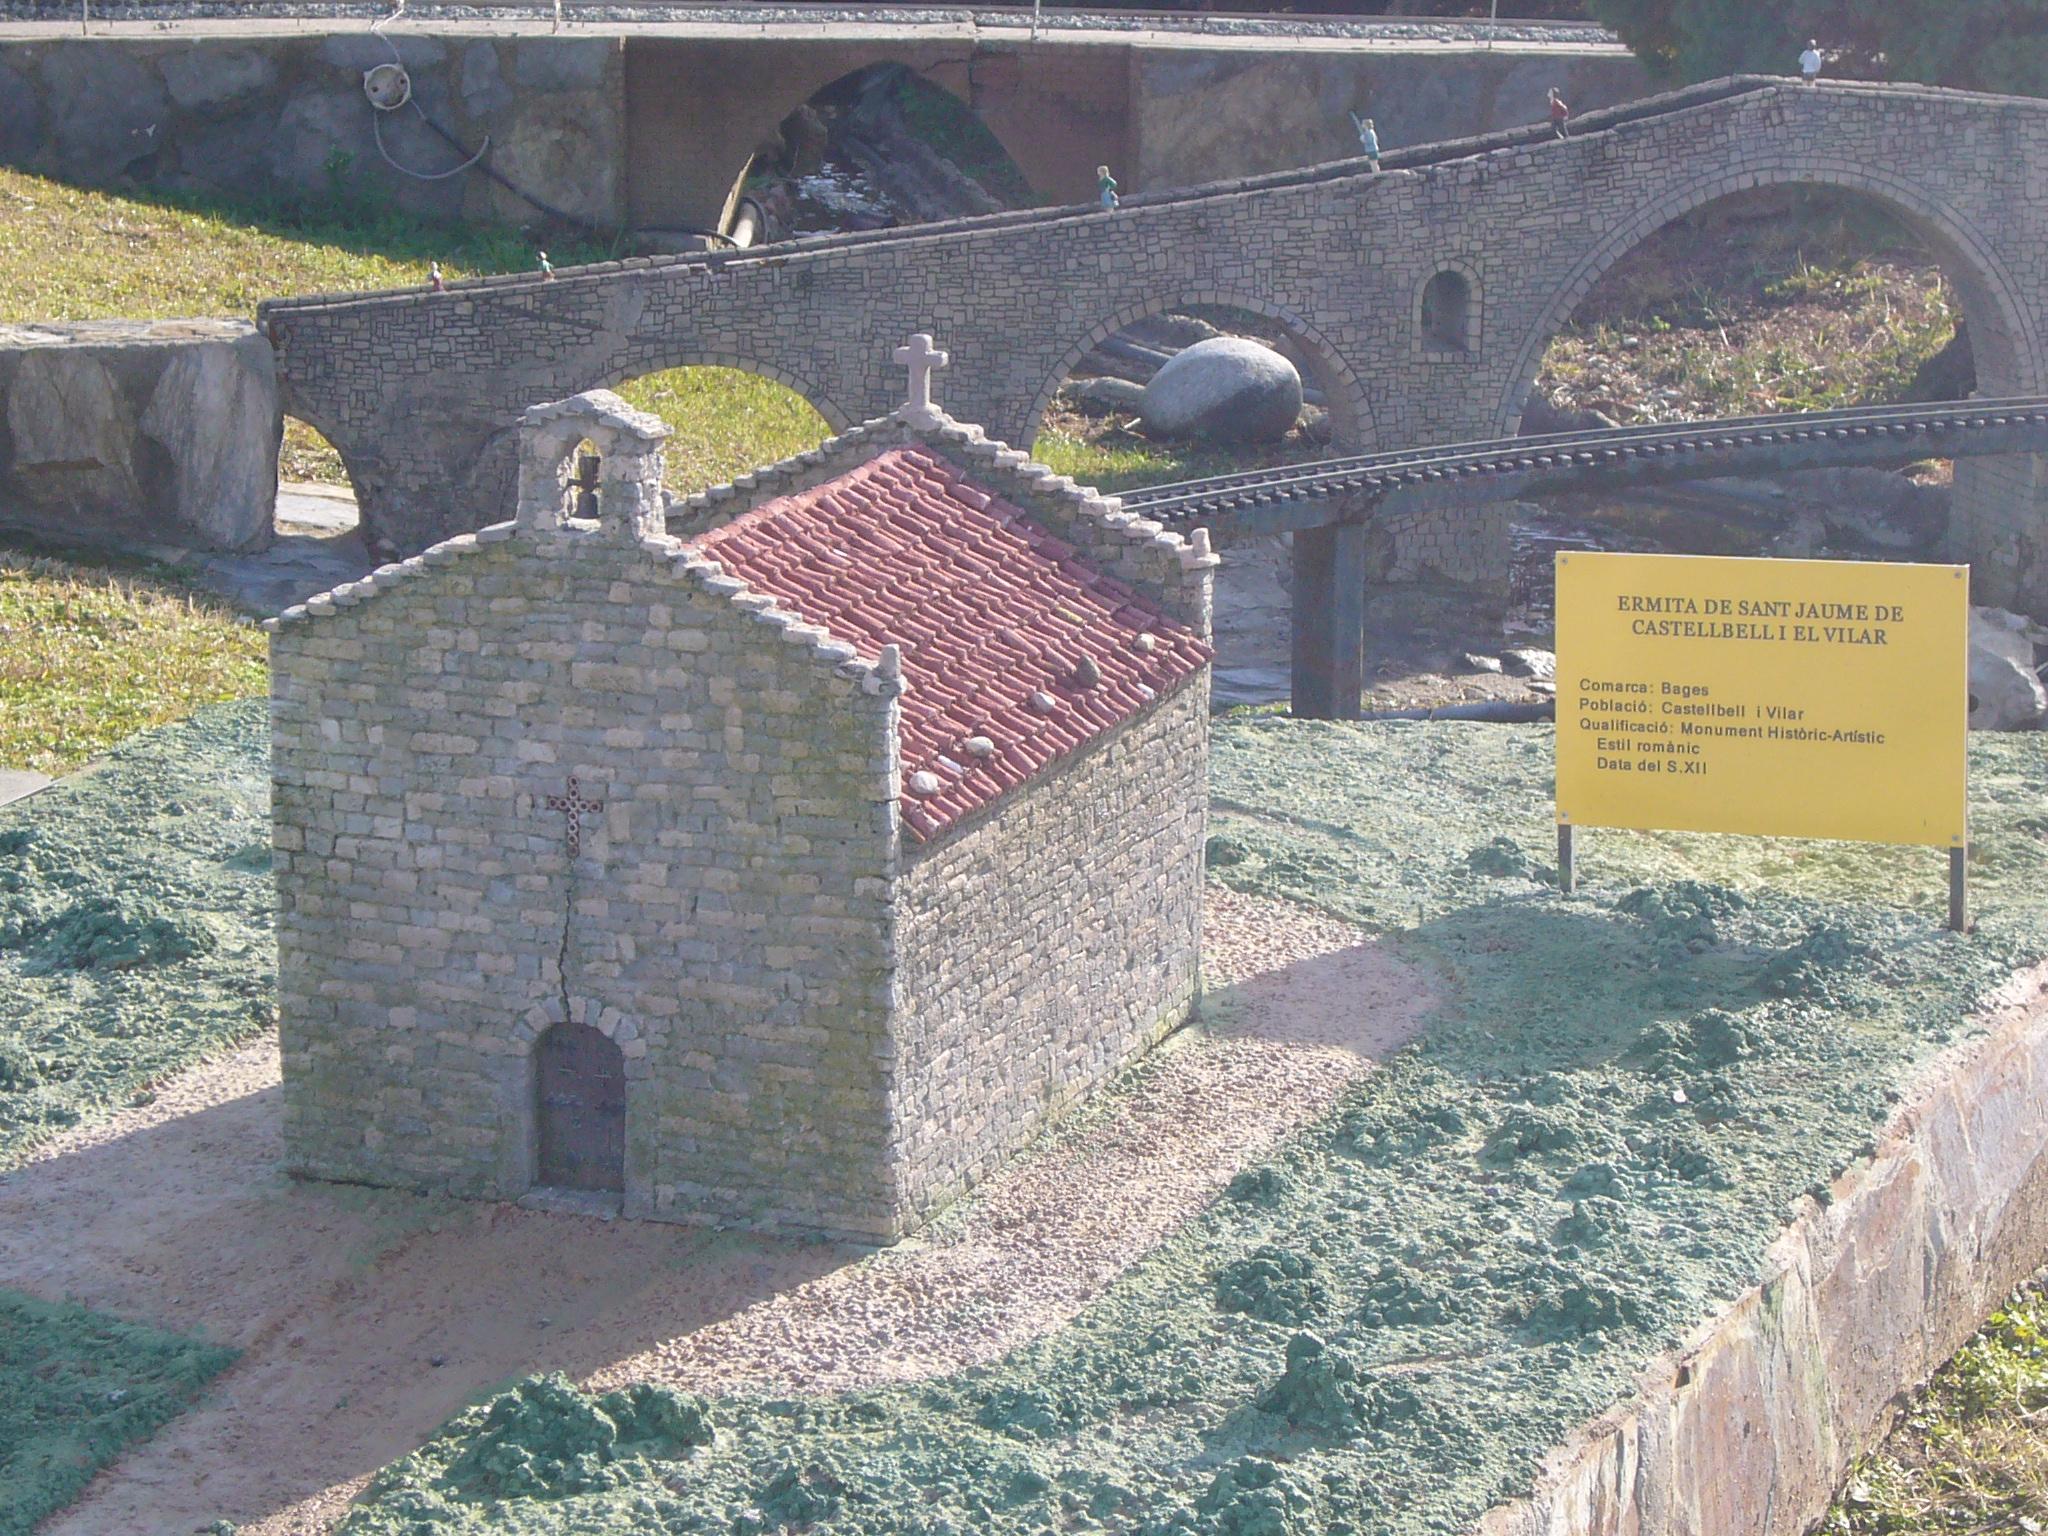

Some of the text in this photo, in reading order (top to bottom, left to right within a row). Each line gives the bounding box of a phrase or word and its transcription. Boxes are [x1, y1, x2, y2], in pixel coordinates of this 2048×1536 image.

[1618, 596, 1904, 622] ERMITA DE SANT JAUME DE
[1632, 619, 1888, 644] CASTELLBELL I EL VILAR
[1580, 678, 1709, 698] Comarca: Bages
[1579, 698, 1804, 720] Població: Castellbell i Vilar
[1580, 717, 1885, 744] Qualificació: Monument Històric-Artístic
[1597, 737, 1700, 754] Estil romànic
[1597, 757, 1707, 775] Data del S.XII
